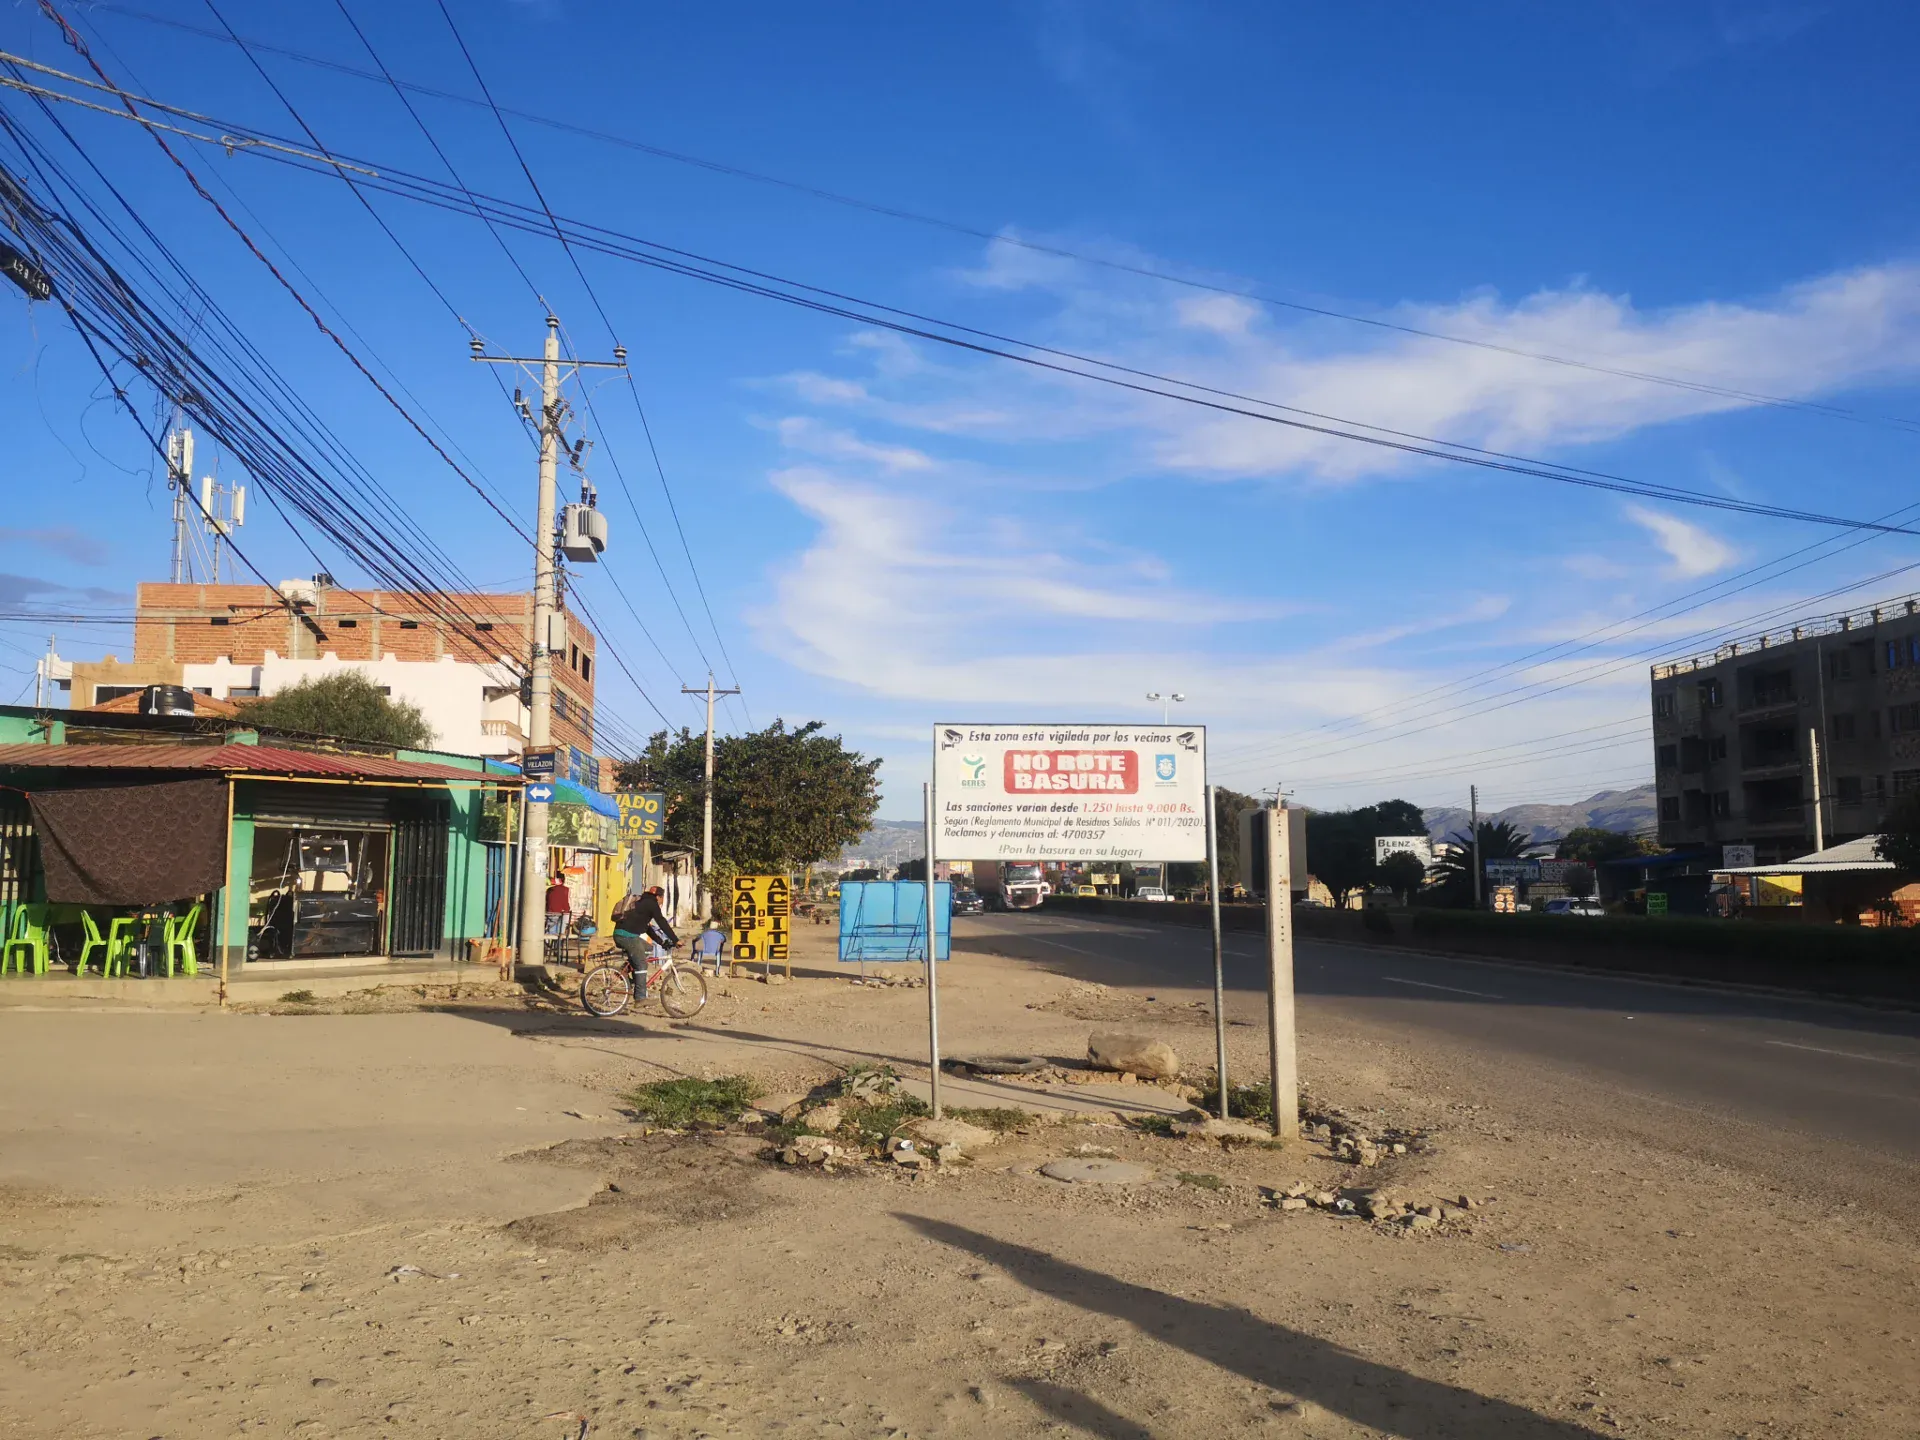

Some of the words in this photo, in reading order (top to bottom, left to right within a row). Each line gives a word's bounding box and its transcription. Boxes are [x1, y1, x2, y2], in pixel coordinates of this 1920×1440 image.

[969, 730, 991, 742] Esta
[994, 732, 1018, 742] zona
[1049, 730, 1089, 744] vigilada
[1093, 733, 1110, 745] por
[1114, 731, 1128, 742] los
[1134, 732, 1172, 743] vecinos
[1013, 754, 1050, 771] NO
[1057, 754, 1126, 772] BOTE
[961, 779, 986, 787] GERES
[1014, 772, 1126, 790] BASURA
[946, 801, 962, 812] Las
[966, 802, 1013, 812] sanciones
[1051, 802, 1079, 813] desde
[1083, 802, 1113, 813] 1.250
[1115, 803, 1143, 813] hasta
[1180, 803, 1196, 814] Bs.
[944, 816, 968, 828] Según
[971, 816, 1022, 828] (Reglamento
[1024, 816, 1062, 829] Municipal
[1064, 817, 1073, 826] de
[1076, 817, 1110, 827] Residuos
[944, 827, 987, 838] Reclamos
[990, 830, 997, 840] y
[998, 827, 1044, 839] denuncias
[1047, 829, 1059, 839] al:
[1061, 830, 1106, 840] 4700357
[1026, 844, 1036, 855] la
[1039, 844, 1075, 856] basura
[1079, 847, 1092, 856] en
[1095, 847, 1107, 856] su
[734, 877, 757, 960] CAMBIO
[757, 908, 766, 928] DE
[767, 877, 787, 960] ACEITE
